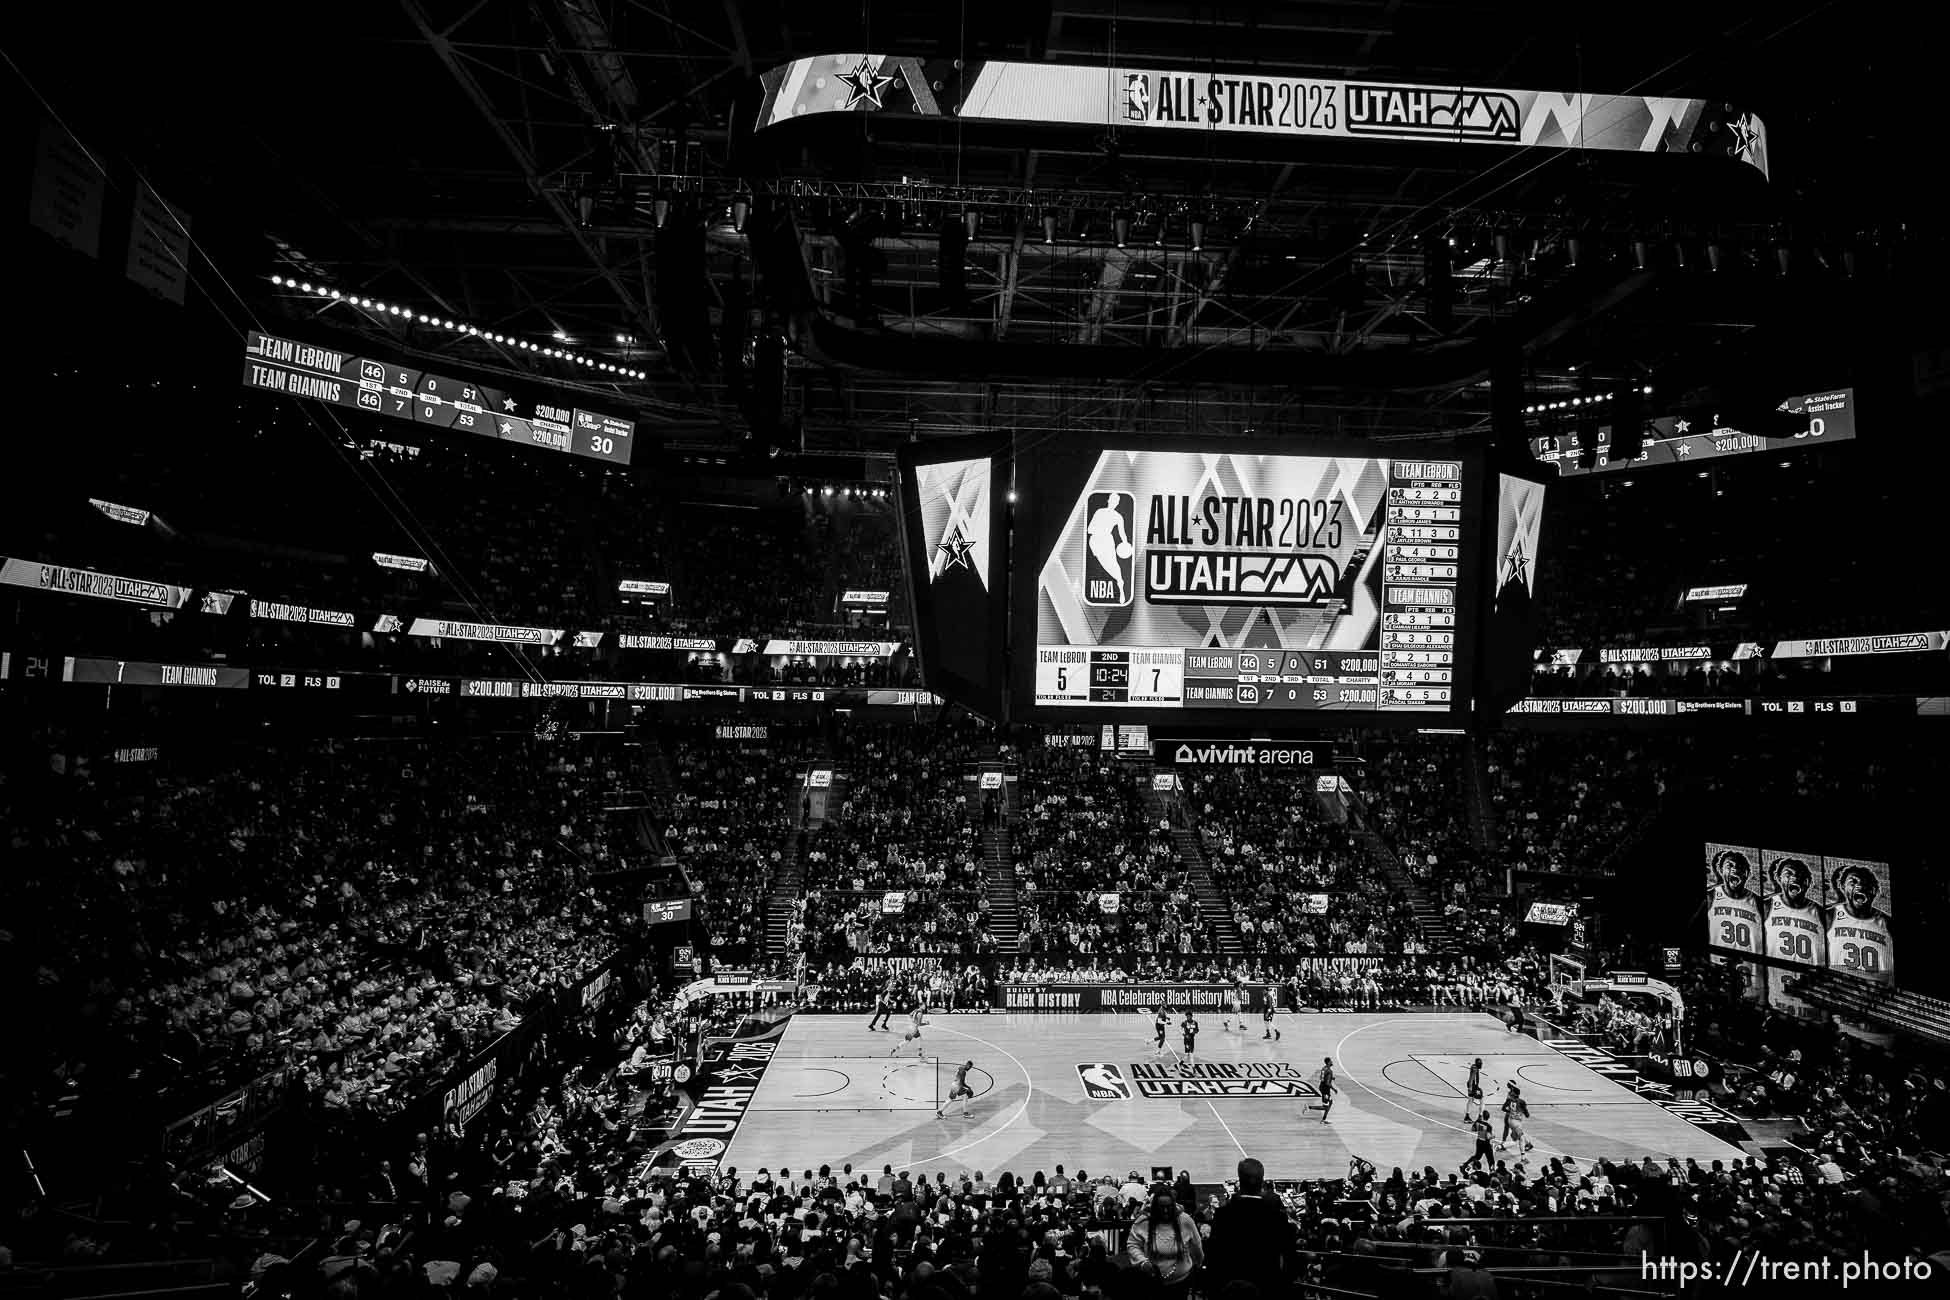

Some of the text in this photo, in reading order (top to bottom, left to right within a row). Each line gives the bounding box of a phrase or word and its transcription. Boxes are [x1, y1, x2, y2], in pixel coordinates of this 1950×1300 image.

[1278, 83, 1336, 130] 2023
[1350, 89, 1428, 124] UTAH
[259, 336, 293, 362] TEAM
[364, 366, 381, 378] 46
[400, 373, 407, 384] 5
[428, 380, 437, 391] 0
[463, 388, 476, 400] 51
[252, 365, 474, 427] TEAM GIANNIS 46 7 0 53
[1814, 393, 1845, 403] State Farm
[536, 405, 570, 423] $200,000
[1807, 401, 1845, 414] Assist Tracker
[532, 430, 567, 447] $200,000
[591, 436, 613, 454] 30
[1571, 432, 1605, 446] 5 0
[1715, 436, 1759, 452] $200,000
[1600, 456, 1607, 466] 0
[1402, 464, 1420, 479] TEAM
[1415, 491, 1457, 500] 2 2 0
[1414, 510, 1455, 519] 9 1 1
[1279, 499, 1342, 549] 2023
[1411, 529, 1455, 538] 11 3 0
[1412, 548, 1454, 557] 4 0 0
[1150, 555, 1238, 592] UTAH
[1411, 567, 1453, 576] 4 1 0
[92, 573, 114, 597] 2023
[115, 577, 142, 597] UTAH
[1090, 580, 1115, 599] NBA
[1394, 589, 1449, 604] TEAM GIANNIS
[290, 604, 307, 622] 2023
[309, 609, 331, 622] UTAH
[1409, 616, 1450, 625] 3 1 0
[476, 624, 494, 639] 2023
[496, 627, 517, 639] UTAH
[1408, 634, 1449, 643] 3 0 0
[656, 637, 672, 649] 2023
[674, 639, 694, 649] UTAH
[821, 642, 860, 654] 2023 UTAH
[1850, 637, 1870, 653] 2023
[1873, 635, 1899, 650] UTAH
[1040, 651, 1058, 664] TEAM
[1102, 653, 1118, 661] 2ND
[1132, 652, 1182, 665] TEAM GIANNIS
[1407, 653, 1414, 661] 2
[1442, 654, 1448, 662] 0
[1641, 648, 1659, 661] 2023
[1661, 647, 1685, 658] UTAH
[25, 657, 48, 677] 24
[1189, 656, 1208, 668] TEAM
[1242, 659, 1256, 668] 46
[1267, 659, 1275, 668] 5
[1290, 659, 1297, 669] 0
[1314, 660, 1328, 669] 51
[1340, 659, 1377, 673] $200,000
[117, 661, 217, 686] 7 TEAM GIANNIS
[258, 674, 337, 688] TOL 2 FLS 0
[1057, 667, 1067, 690] 5
[1096, 668, 1128, 682] 10:24
[1151, 669, 1161, 693] 7
[1406, 672, 1447, 681] 4 0 0
[418, 679, 441, 687] RAISE
[418, 686, 450, 694] FUTURE
[469, 680, 512, 697] $200,000
[580, 685, 603, 695] UTAH
[634, 687, 675, 701] $200,000
[752, 692, 807, 700] TOL 2 FLS
[898, 692, 915, 704] TEAM
[1102, 690, 1116, 700] 24
[1186, 687, 1377, 703] TEAM GIANNIS 46 7 0 53 $200,000
[1406, 691, 1447, 700] 6 5 0
[1543, 700, 1585, 713] 2023 UTAH
[1621, 701, 1666, 715] $200,000
[1761, 702, 1852, 712] TOL 2 FLS 0
[752, 726, 768, 738] 2023
[1197, 745, 1313, 764] vivint arena
[661, 911, 673, 920] 30
[1713, 907, 1758, 923] NEW YORK
[1771, 916, 1819, 934] NEW YORK
[1720, 920, 1751, 947] 30
[1834, 927, 1887, 946] NEW YORK
[1778, 931, 1812, 960] 30
[1843, 942, 1879, 972] 30
[1006, 993, 1081, 1008] BLACK HISTORY
[1101, 989, 1222, 1008] NBA Celebrates Black History
[726, 1042, 777, 1061] 2023
[1540, 1039, 1640, 1074] UTAH
[1240, 1063, 1301, 1079] 2023
[1092, 1090, 1117, 1098] NBA
[1140, 1081, 1226, 1095] UTAH
[681, 1086, 756, 1133] UTAH
[1650, 1099, 1738, 1124] 2023
